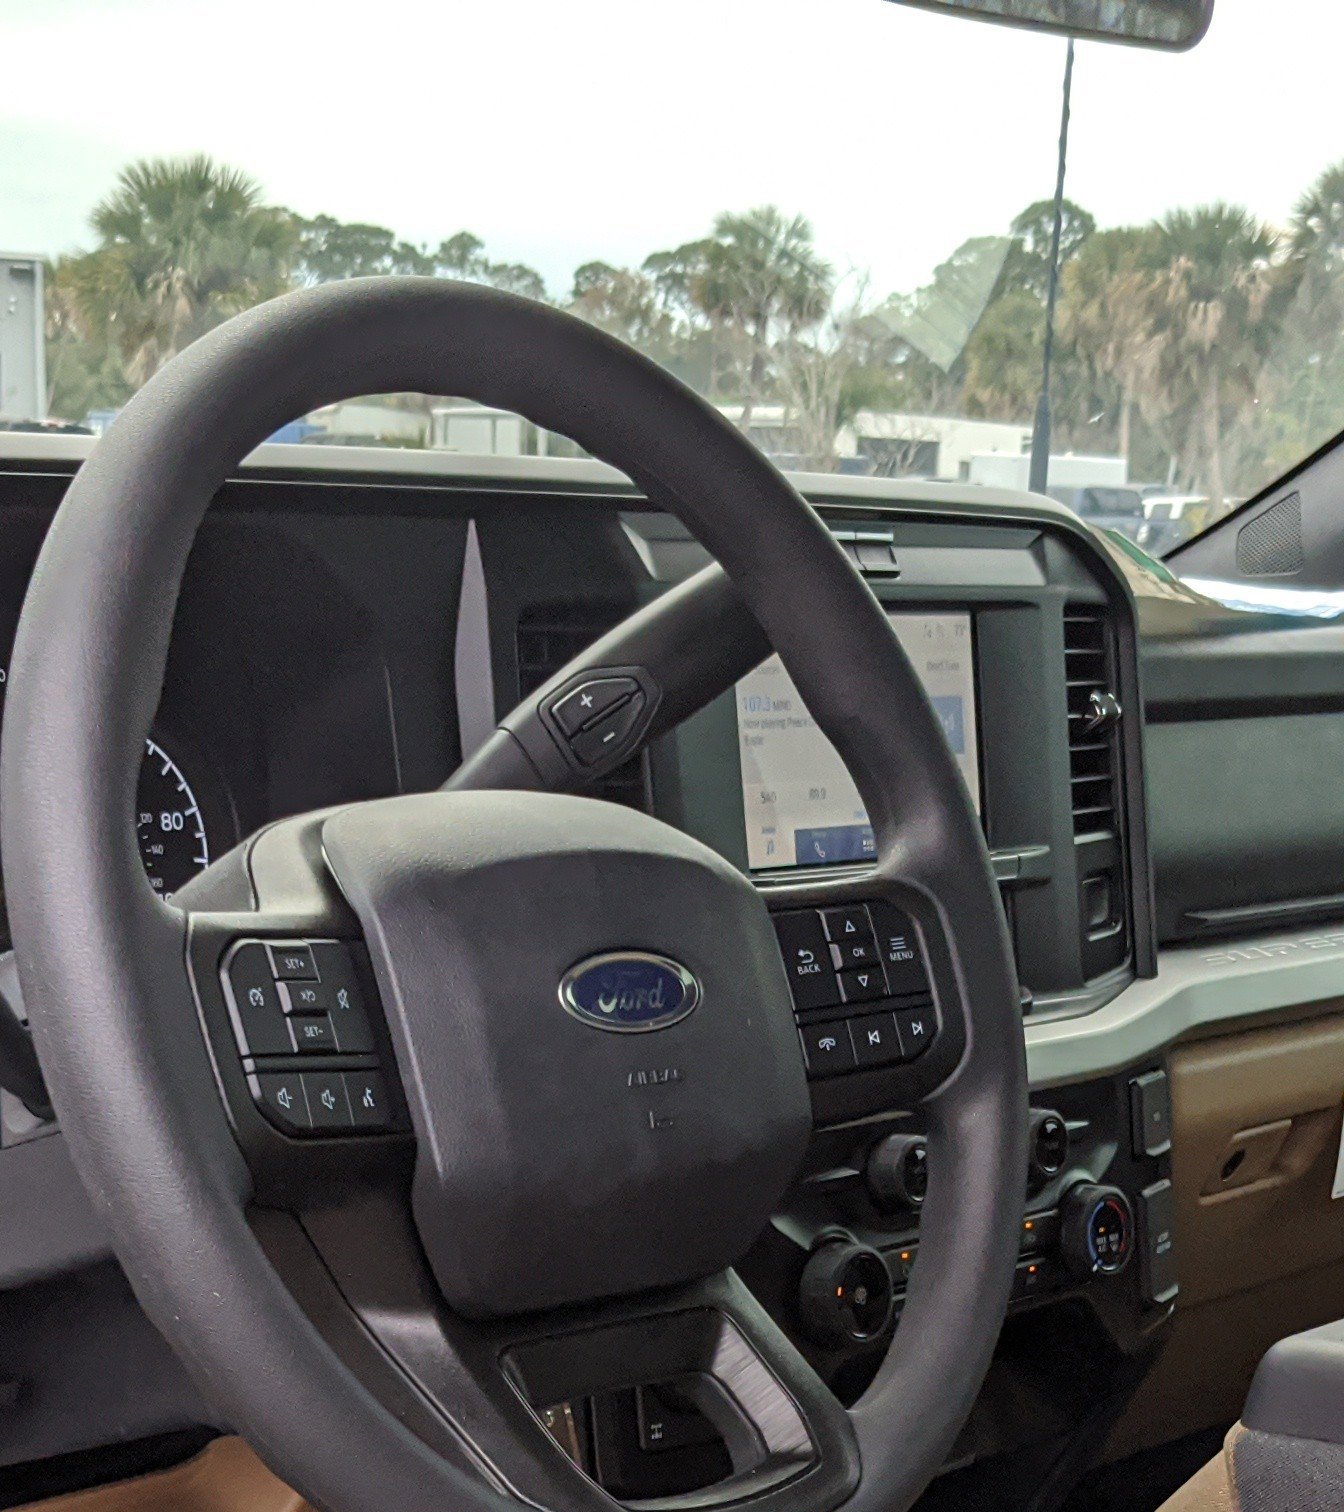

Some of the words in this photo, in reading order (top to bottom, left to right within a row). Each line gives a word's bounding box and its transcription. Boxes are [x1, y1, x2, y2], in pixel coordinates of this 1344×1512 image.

[160, 812, 184, 831] 80
[852, 947, 865, 958] OK
[889, 951, 914, 962] MENU
[797, 963, 821, 976] BACK
[597, 976, 666, 1014] Ford
